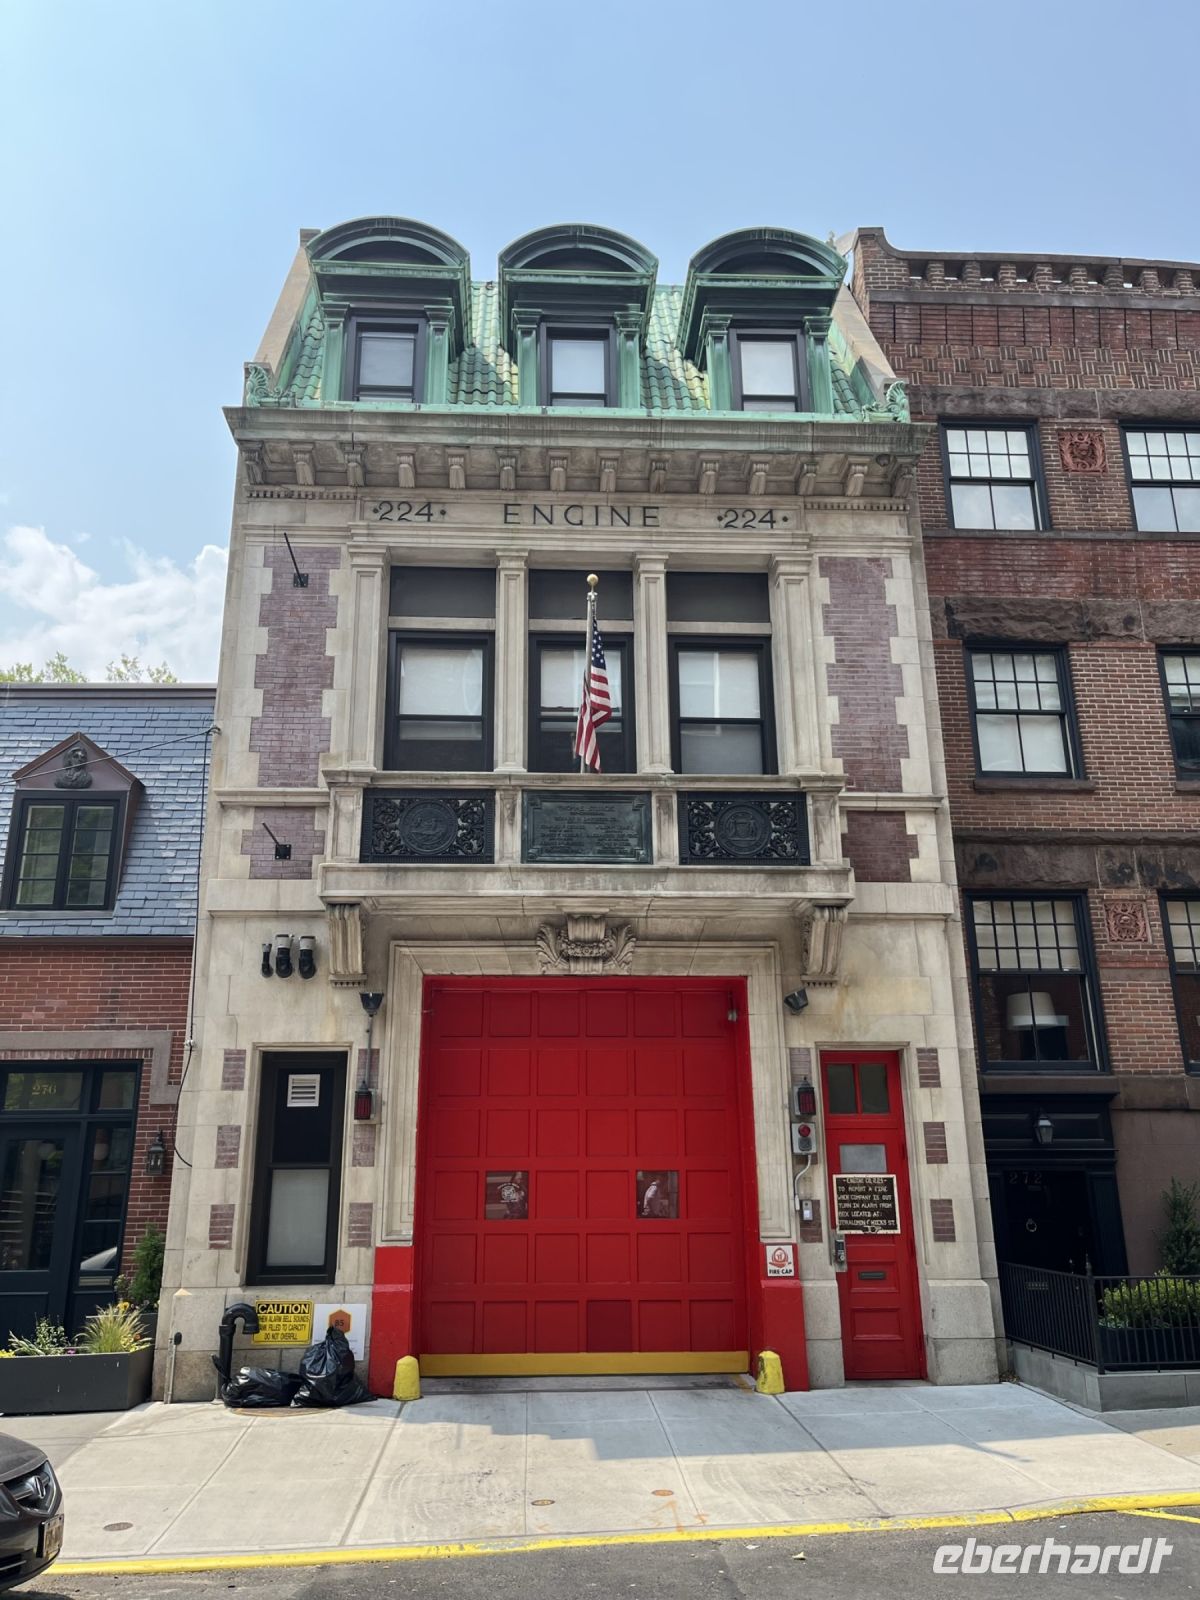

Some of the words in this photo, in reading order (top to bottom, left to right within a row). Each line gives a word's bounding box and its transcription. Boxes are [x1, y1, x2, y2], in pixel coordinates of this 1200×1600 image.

[503, 503, 661, 527] ENGINE
[31, 1080, 57, 1096] 276
[1009, 1171, 1042, 1184] 272
[258, 1304, 309, 1314] CAUTION
[264, 1332, 270, 1340] DO
[272, 1332, 280, 1340] NOT
